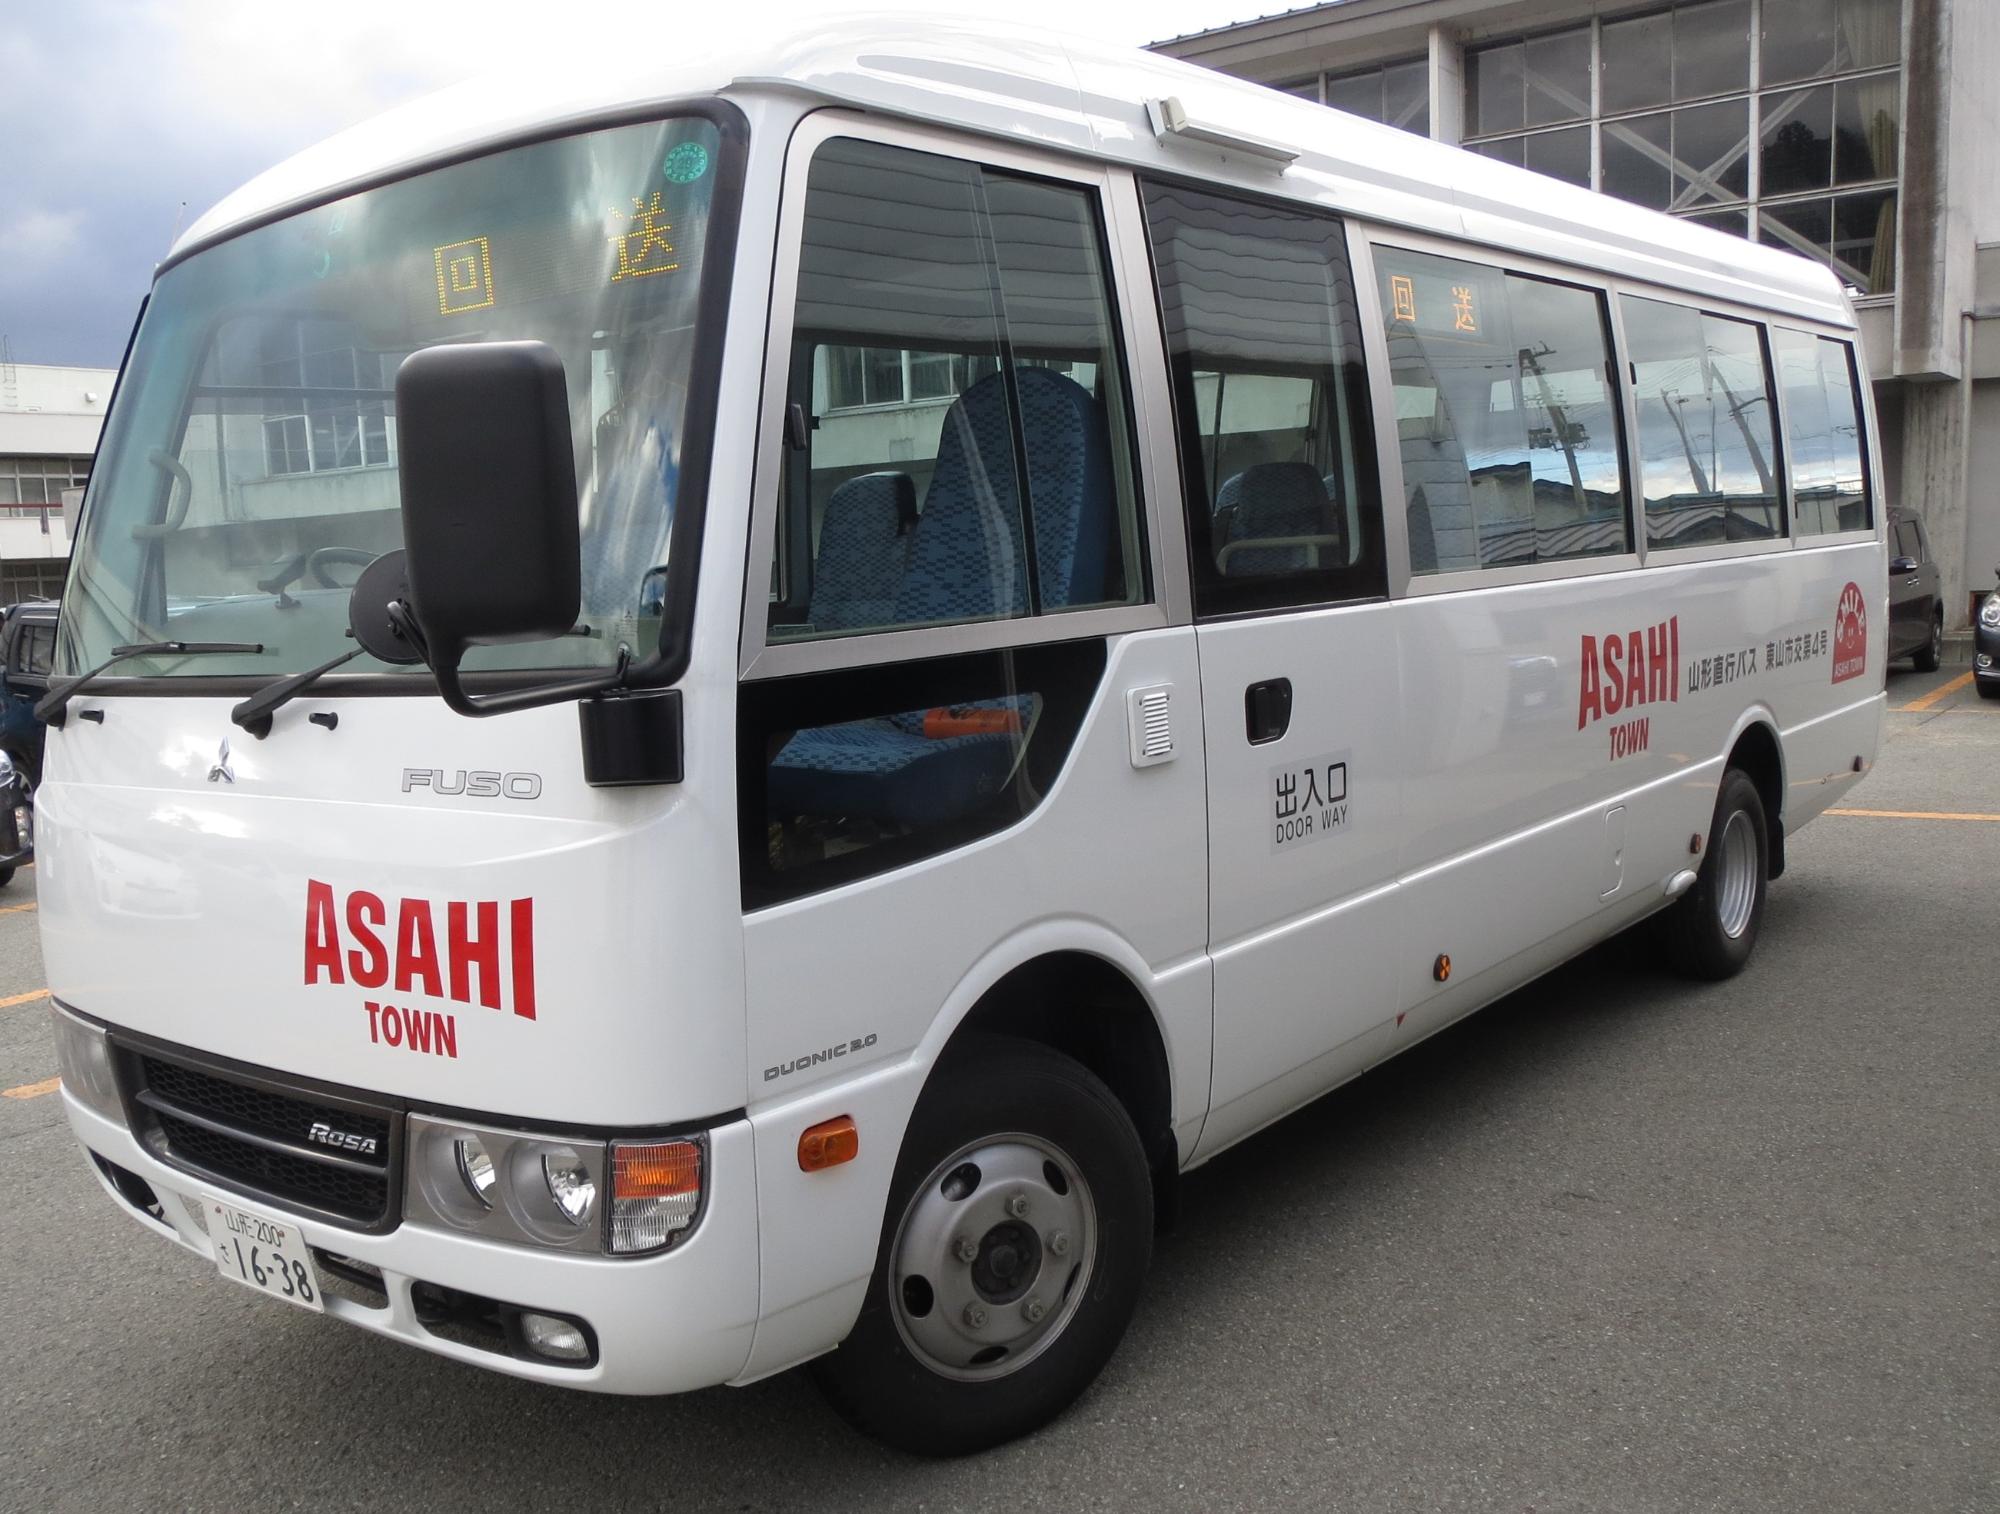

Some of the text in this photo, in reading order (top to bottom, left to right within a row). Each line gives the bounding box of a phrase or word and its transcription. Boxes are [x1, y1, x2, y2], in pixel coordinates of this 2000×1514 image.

[1578, 615, 1678, 731] ASAHI
[1688, 648, 1757, 694] 山形直行バス
[1610, 717, 1649, 761] TOWN
[401, 768, 542, 800] FUSO
[1276, 762, 1346, 819] 出入口
[1276, 804, 1347, 844] DOOR WAY
[304, 879, 536, 1021] ASAHI
[364, 1001, 458, 1059] TOWN
[764, 1043, 847, 1081] DUONIC
[233, 1237, 314, 1303] 16-38
